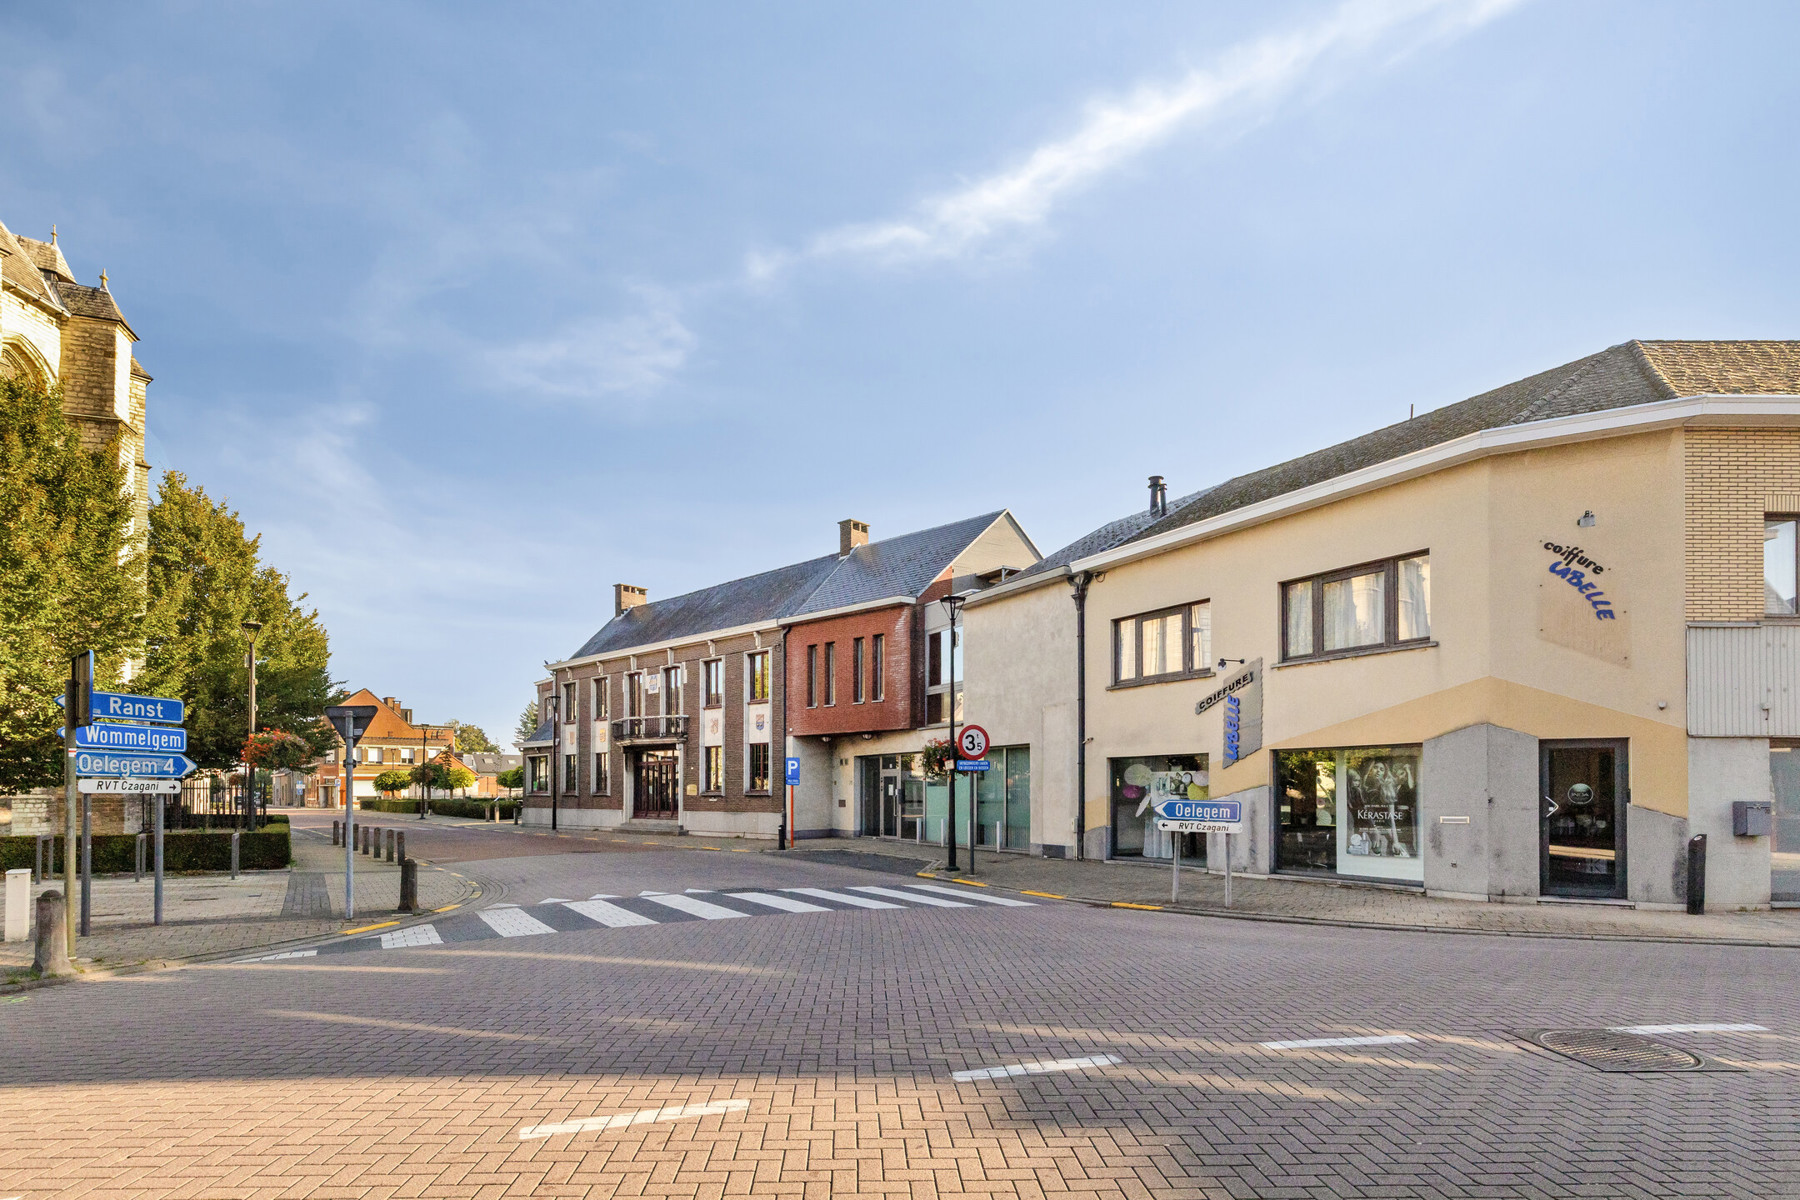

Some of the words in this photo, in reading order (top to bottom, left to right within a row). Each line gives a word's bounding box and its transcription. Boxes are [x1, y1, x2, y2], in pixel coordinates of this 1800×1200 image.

[1543, 541, 1604, 575] coiffure
[1548, 560, 1616, 621] LABELLE
[1198, 673, 1249, 710] COIFFURE
[109, 696, 164, 718] Ranst
[85, 725, 181, 751] Wommelgem
[1225, 693, 1241, 760] LABELLE
[78, 753, 158, 777] Oelegem
[163, 758, 175, 774] 4
[787, 760, 799, 775] P
[96, 780, 119, 791] RVT
[121, 780, 160, 793] Czagani
[1175, 803, 1231, 821] Oelegem
[1357, 809, 1404, 820] KÉRASTASE
[1178, 822, 1195, 830] RVT
[1196, 823, 1230, 833] Czagani
